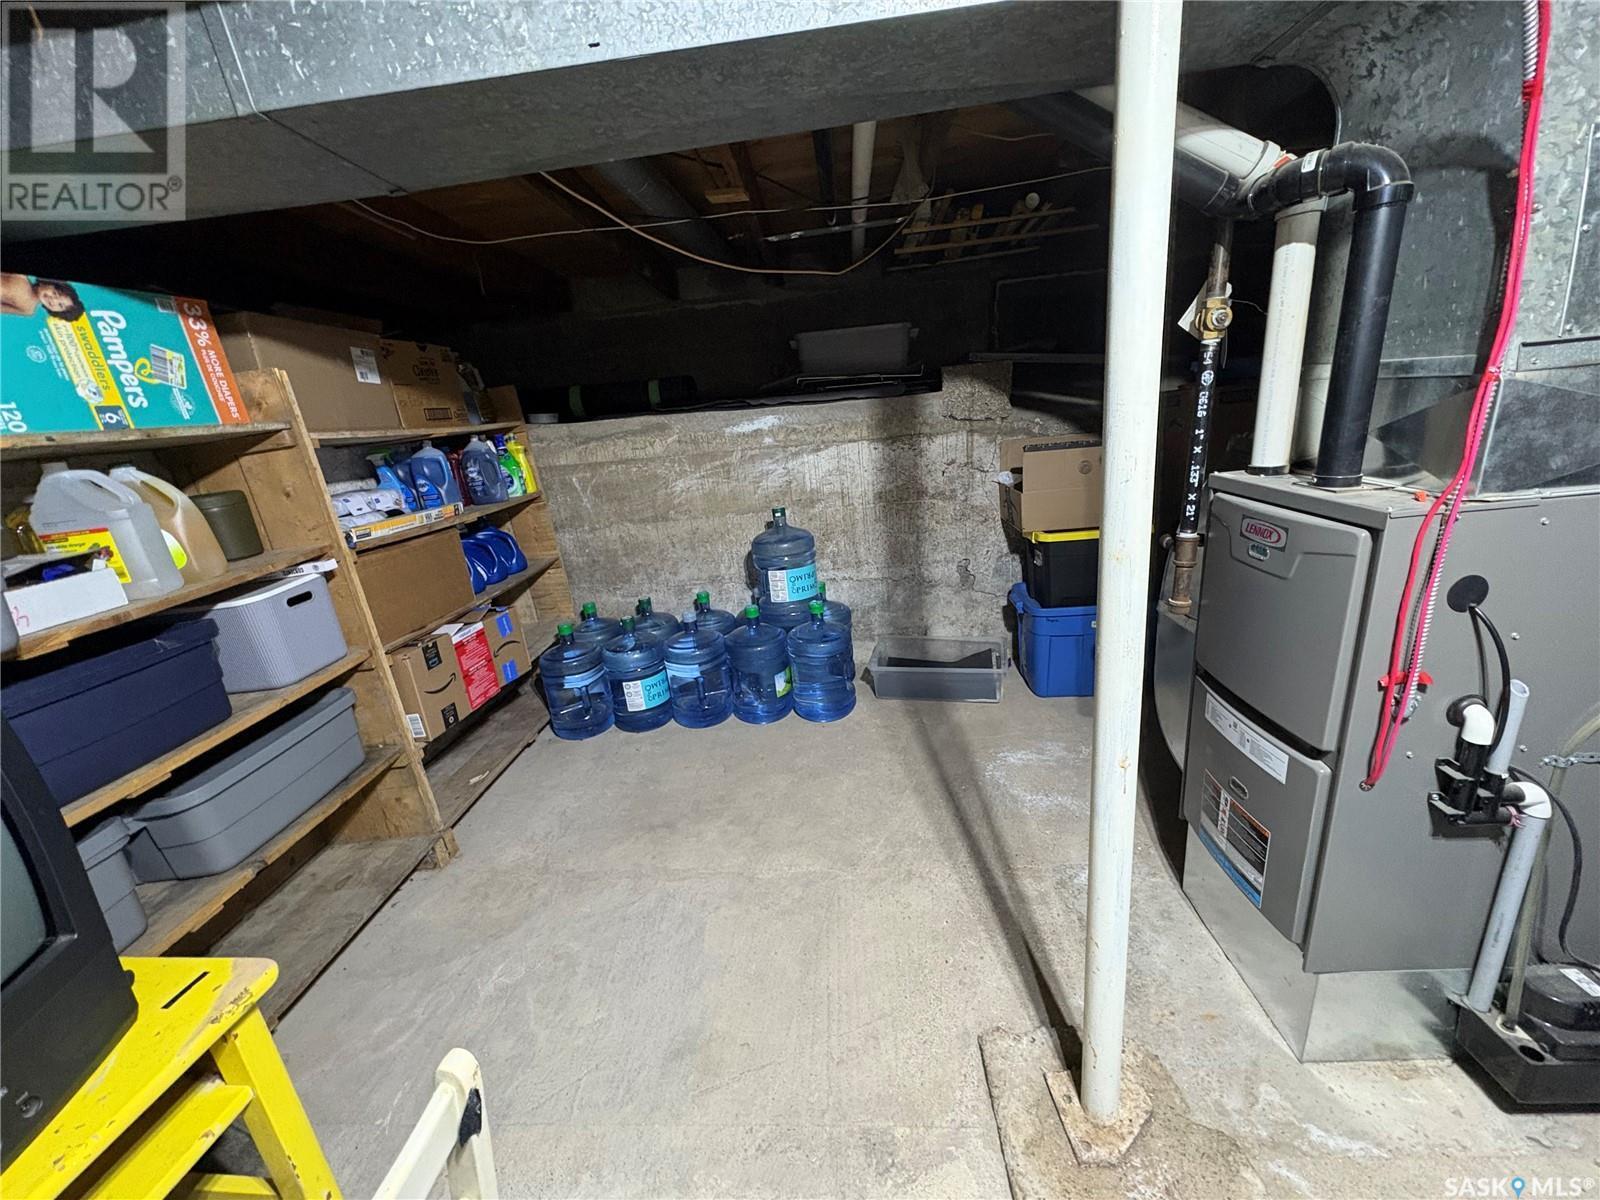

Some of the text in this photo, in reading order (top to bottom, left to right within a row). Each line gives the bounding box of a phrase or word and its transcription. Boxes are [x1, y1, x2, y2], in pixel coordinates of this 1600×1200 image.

[183, 302, 212, 347] 33%
[207, 349, 224, 377] MORE
[76, 325, 111, 391] swaddlers
[90, 310, 148, 409] Pampers
[0, 401, 28, 433] 120
[105, 412, 121, 424] 6
[1187, 493, 1197, 501] X
[1245, 522, 1274, 541] LENNOX
